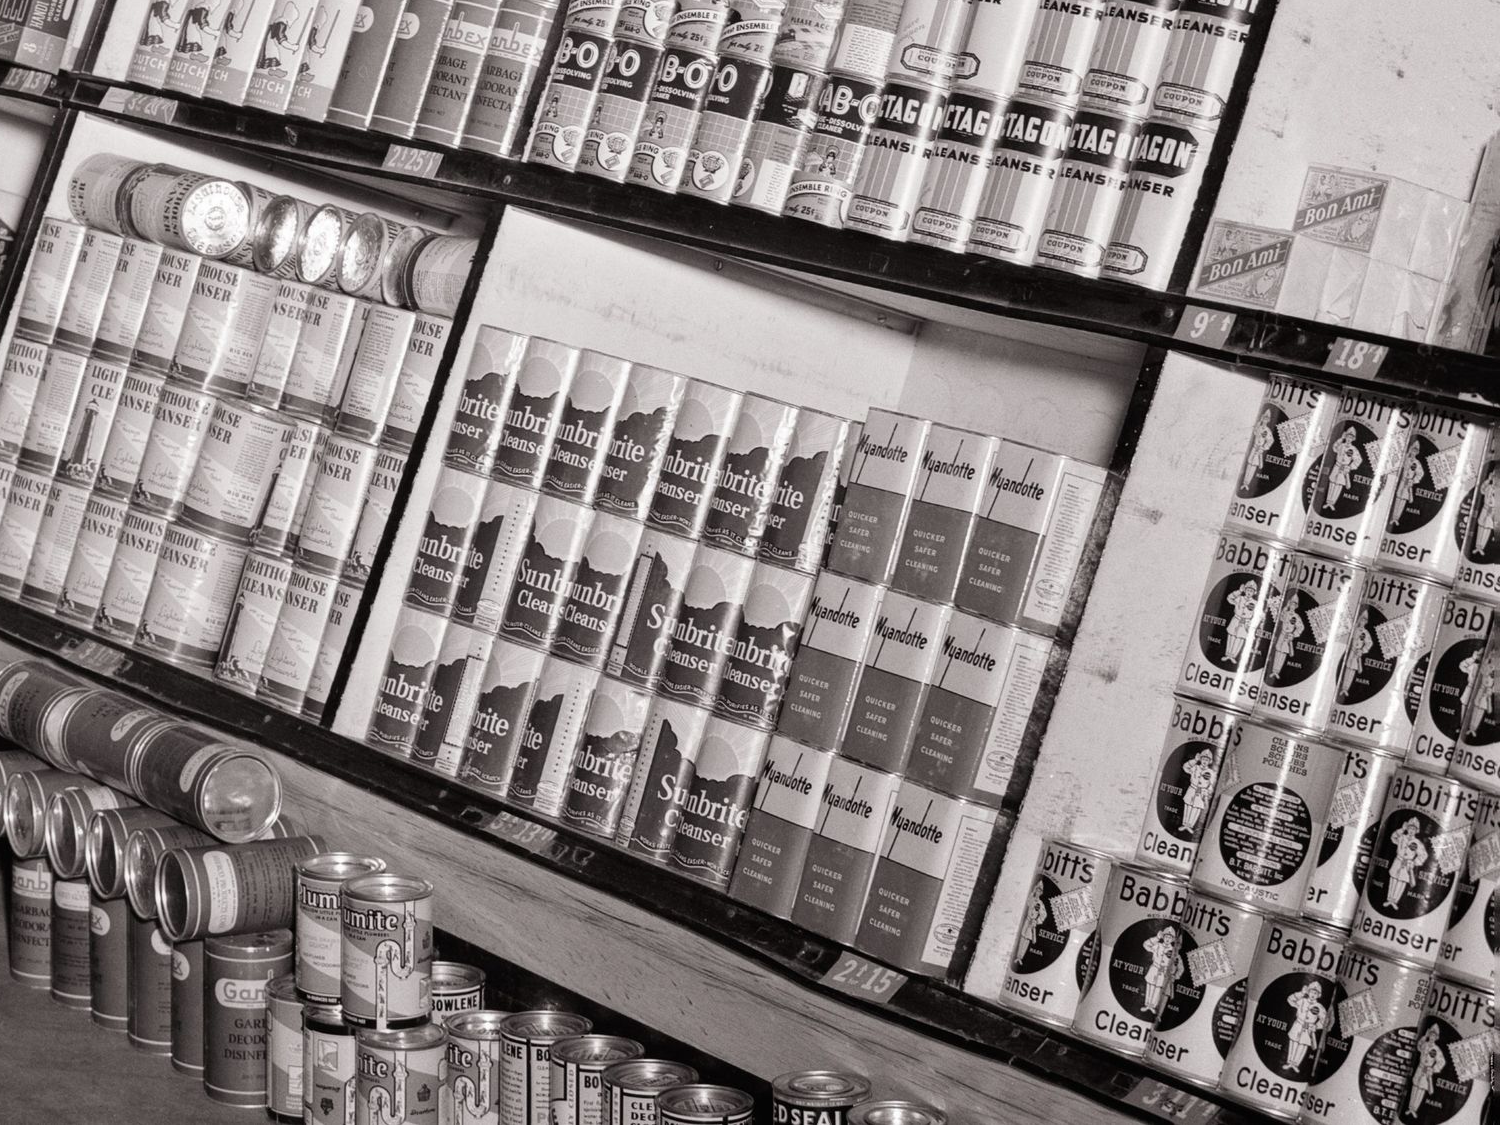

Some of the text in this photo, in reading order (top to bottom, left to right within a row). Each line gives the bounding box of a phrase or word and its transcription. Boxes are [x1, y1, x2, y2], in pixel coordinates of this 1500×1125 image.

[1091, 79, 1125, 92] COUPON
[1164, 92, 1203, 106] COUPON
[1304, 189, 1375, 226] Bon Ami
[1209, 243, 1280, 282] Bon Ami
[921, 445, 975, 490] Wyandotte
[1266, 454, 1292, 467] SERVICE
[1415, 488, 1443, 501] SERVICE
[913, 529, 946, 544] QUICKER
[914, 545, 937, 557] SAFER
[905, 559, 938, 573] CLEANING
[874, 612, 928, 659] Wyandotte
[865, 695, 897, 711] QUICKER
[866, 712, 887, 724] SAFER
[856, 725, 887, 741] CLEANING
[889, 803, 942, 851] Wyandotte
[1221, 878, 1235, 887] NO
[1270, 1019, 1288, 1031] YOUR
